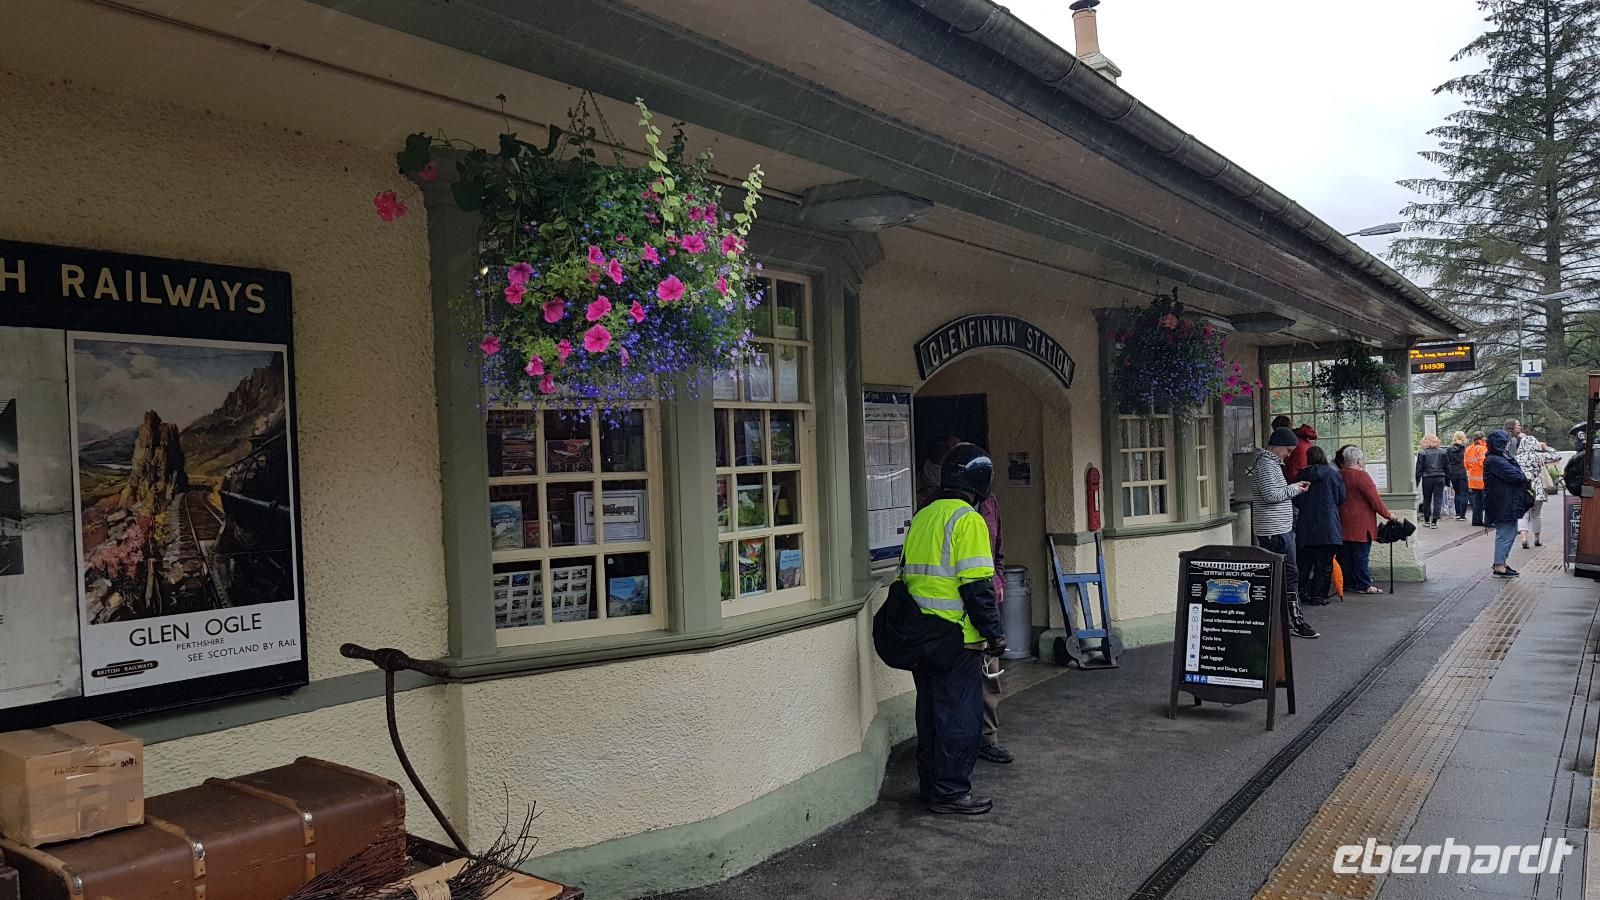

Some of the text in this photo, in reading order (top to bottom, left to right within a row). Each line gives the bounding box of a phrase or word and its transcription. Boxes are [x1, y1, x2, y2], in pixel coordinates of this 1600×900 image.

[61, 264, 266, 314] RAILWAYS
[929, 319, 1070, 378] GLENFINNAN STATION
[1528, 361, 1535, 372] 1
[129, 612, 262, 647] GLEN OGLE
[176, 637, 224, 650] PERTHSHIRE
[187, 638, 297, 662] SEE SCOTLAND BY RAIL
[96, 662, 154, 676] BRITISH RAILWAYS
